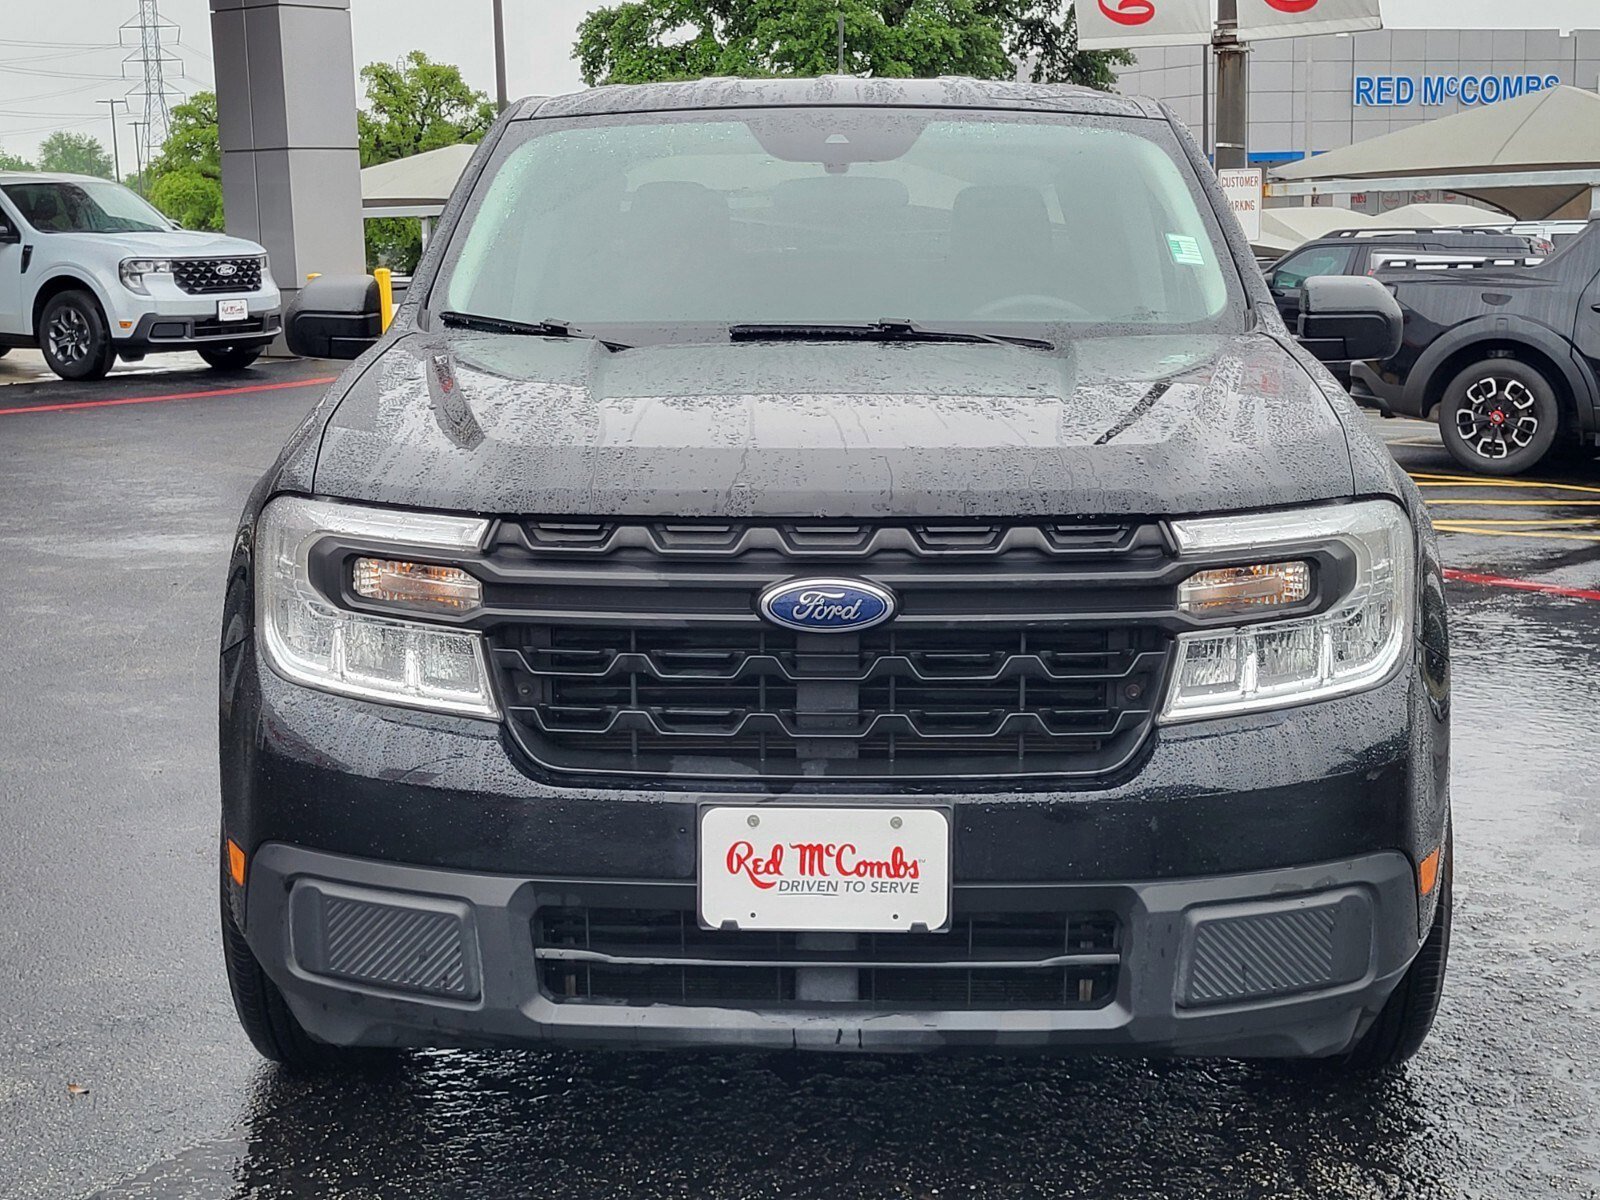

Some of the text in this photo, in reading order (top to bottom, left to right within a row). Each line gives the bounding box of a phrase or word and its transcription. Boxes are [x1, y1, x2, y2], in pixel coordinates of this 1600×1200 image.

[1355, 76, 1414, 105] RED
[1221, 176, 1259, 188] CUSTOMER
[793, 590, 863, 620] Ford
[726, 840, 920, 889] Red McCombs
[778, 879, 920, 894] DRIVEN TO SERVE
